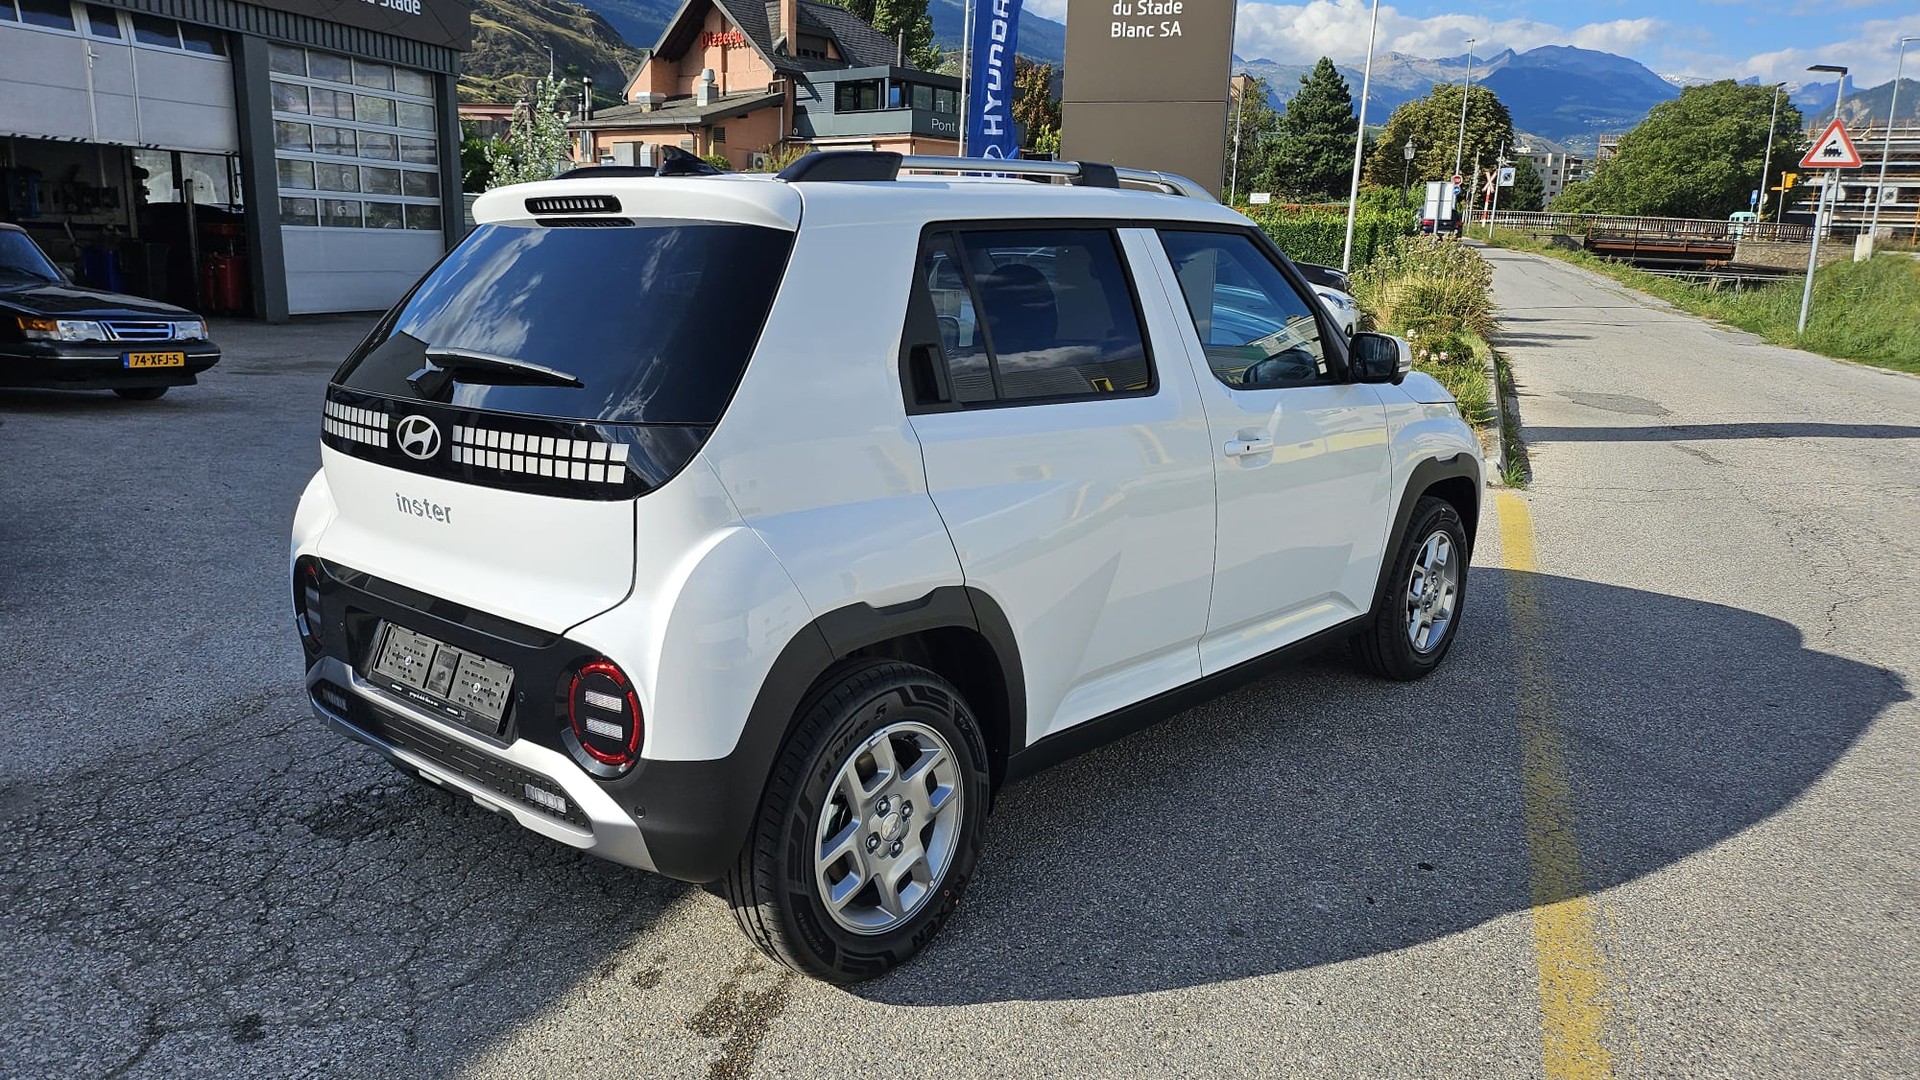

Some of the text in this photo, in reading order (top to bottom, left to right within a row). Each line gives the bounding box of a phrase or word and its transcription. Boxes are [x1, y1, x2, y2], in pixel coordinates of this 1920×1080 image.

[1113, 0, 1183, 16] du Stade
[1111, 21, 1182, 37] Blanc SA
[931, 118, 956, 132] Pont
[134, 355, 179, 366] 74-XFJ-5
[395, 492, 452, 524] inster
